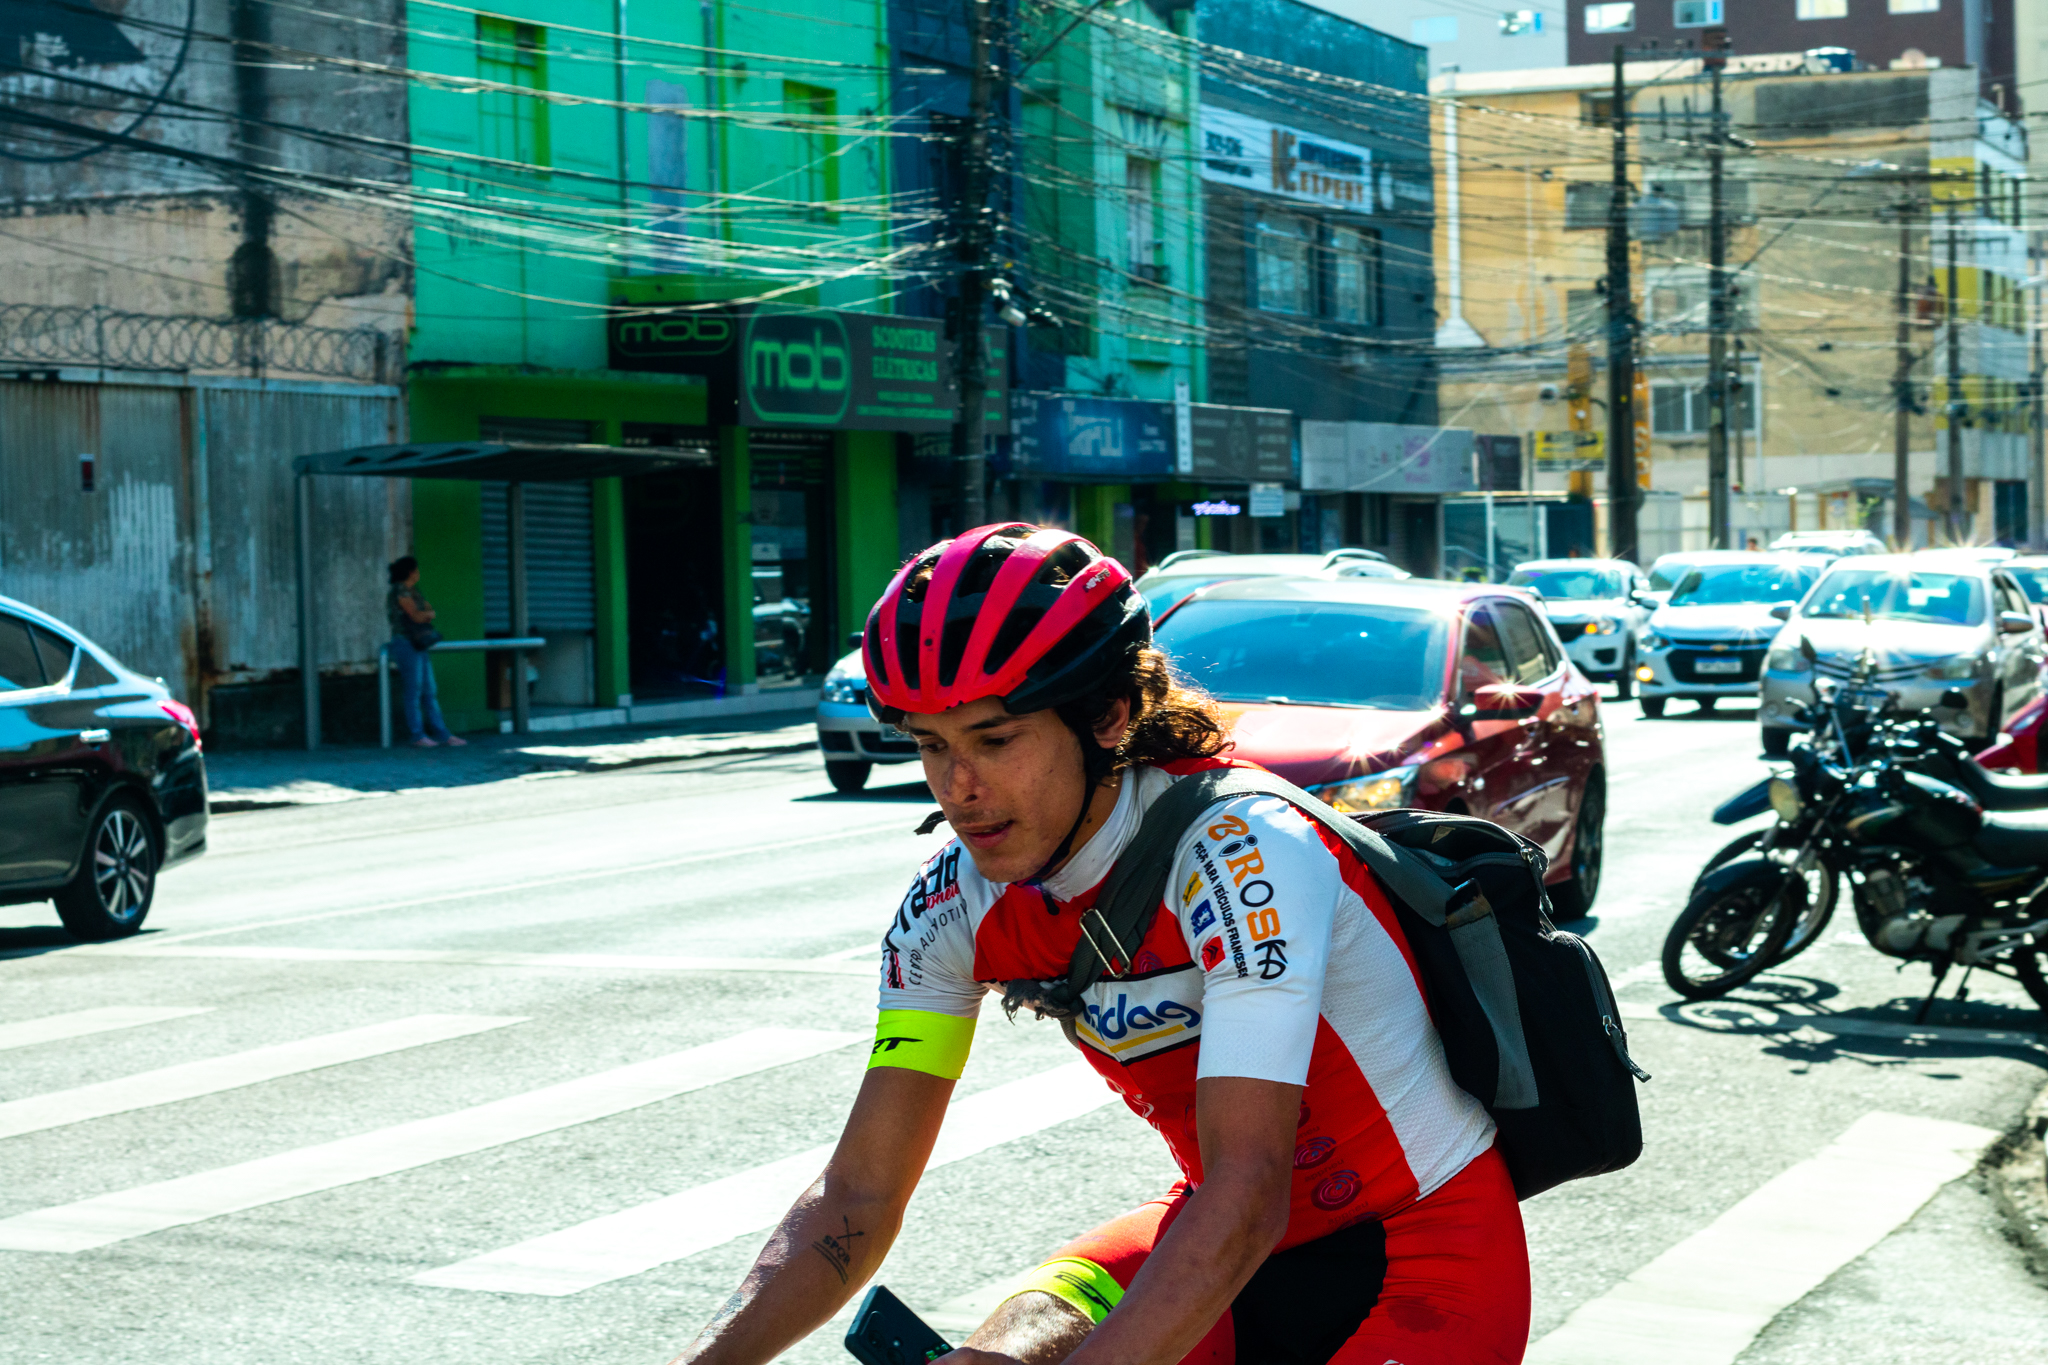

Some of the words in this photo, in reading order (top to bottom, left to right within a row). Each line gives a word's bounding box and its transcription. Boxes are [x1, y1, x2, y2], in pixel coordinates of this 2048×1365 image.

[619, 313, 730, 342] mob
[750, 328, 846, 390] mob
[1213, 879, 1236, 928] VEÍCULOS
[1304, 1157, 1345, 1183] appneu
[1327, 1200, 1369, 1226] appneu
